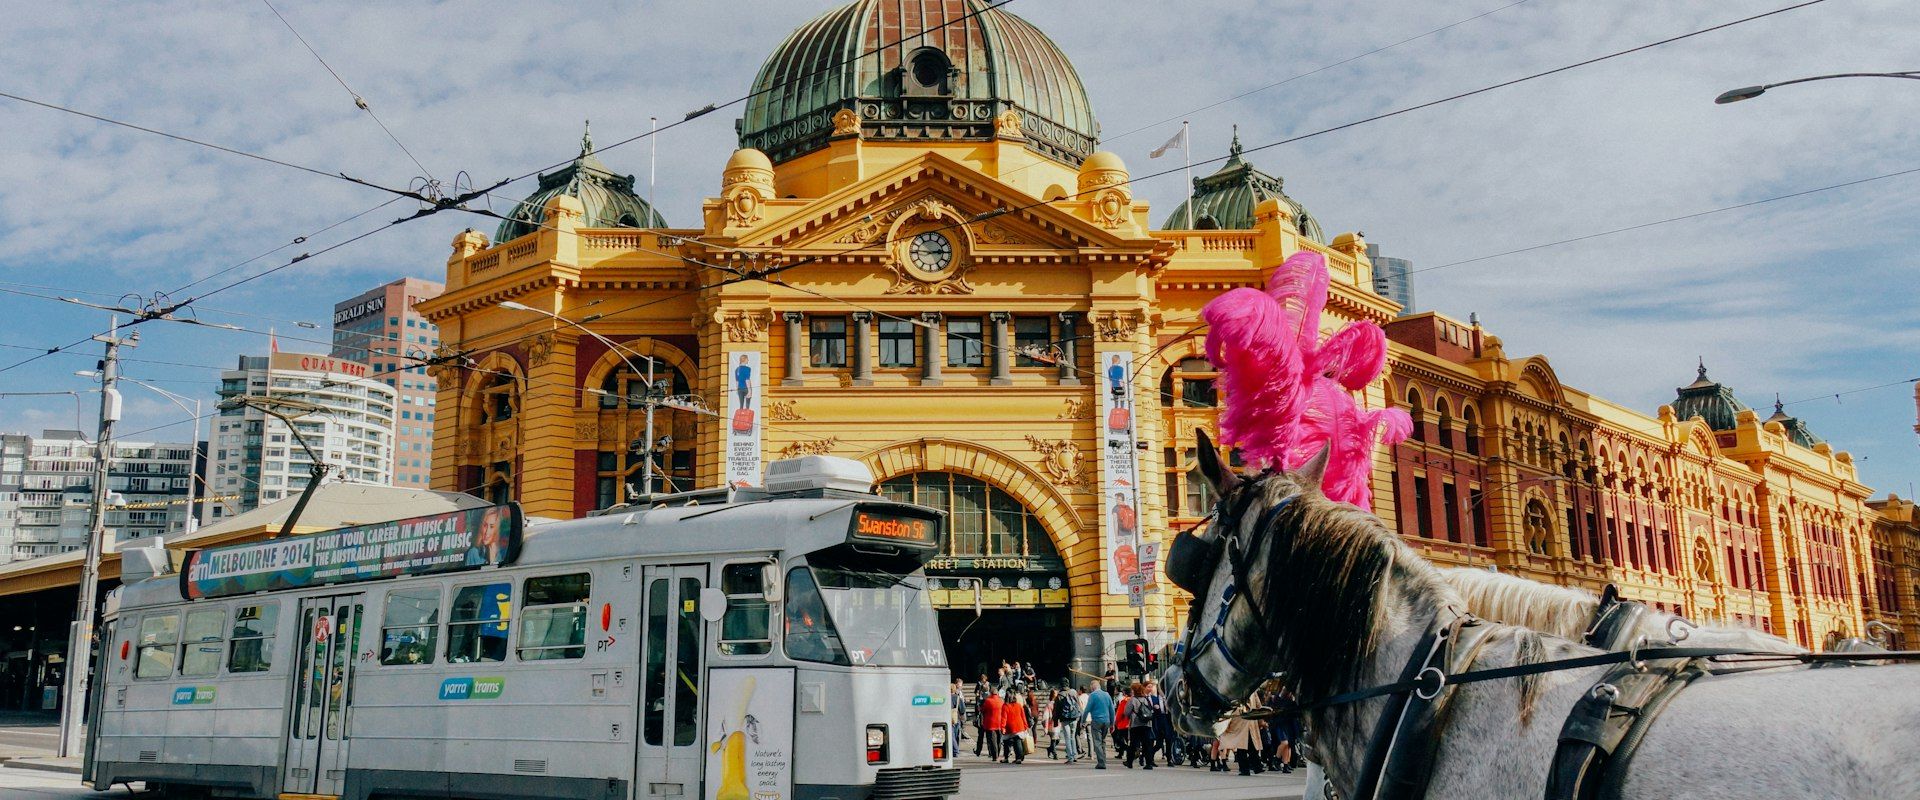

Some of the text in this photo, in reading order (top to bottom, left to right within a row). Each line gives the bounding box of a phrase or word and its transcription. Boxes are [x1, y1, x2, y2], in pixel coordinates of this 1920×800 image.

[366, 297, 385, 313] SUN
[301, 357, 366, 378] QUAY WEST
[316, 517, 458, 550] START YOUR CAREER IN MUSIC AT
[858, 515, 926, 540] Swanston St
[315, 532, 473, 567] THE AUSTRALIAN INSTITUTE OF MUSIC
[210, 546, 277, 575] MELBOURNE
[282, 542, 311, 566] 2014
[973, 558, 1028, 570] STATION
[921, 649, 941, 666] 167
[444, 681, 500, 697] yarra trams
[754, 749, 782, 757] Nature's
[751, 760, 786, 770] long lasting
[757, 771, 779, 779] energy
